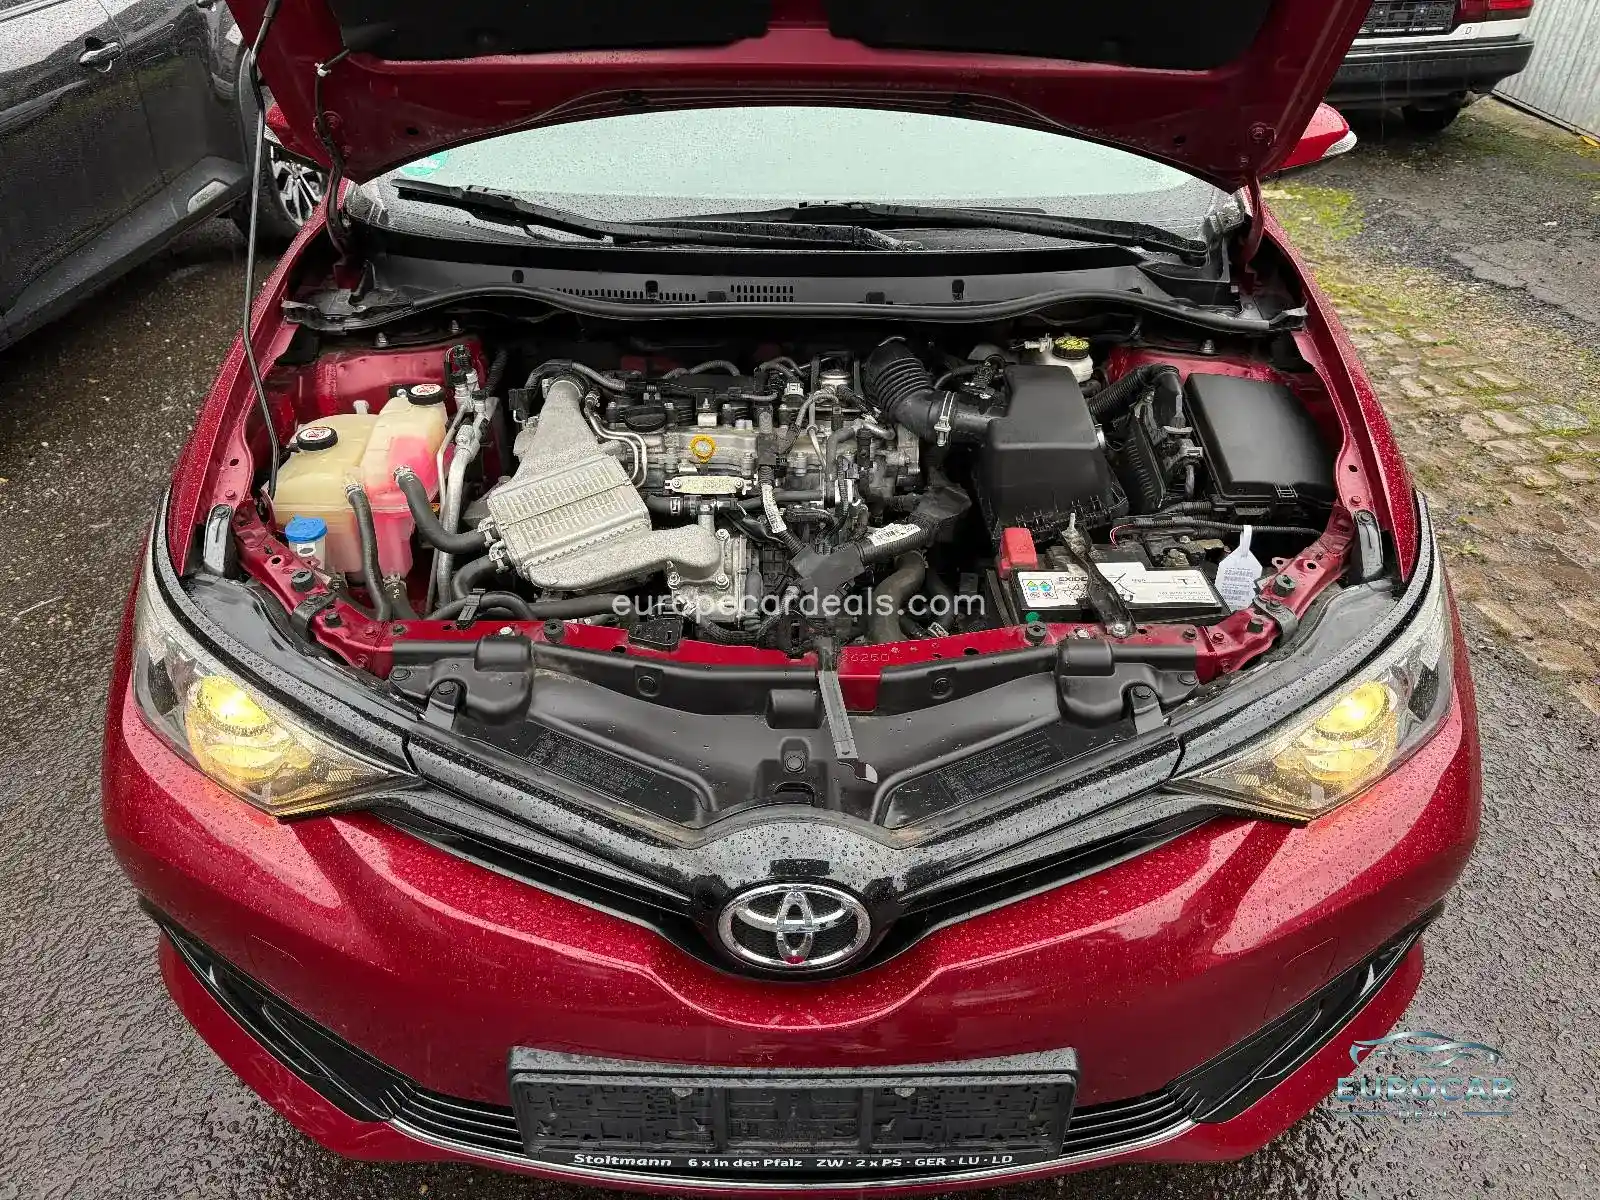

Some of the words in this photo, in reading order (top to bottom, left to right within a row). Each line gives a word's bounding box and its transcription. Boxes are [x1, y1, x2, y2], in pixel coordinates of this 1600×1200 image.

[574, 1154, 672, 1167] Stoltmann
[688, 1158, 698, 1167] 6
[714, 1158, 728, 1167] in
[732, 1158, 759, 1167] der
[763, 1158, 803, 1168] Pfalz
[816, 1158, 844, 1167] ZW
[856, 1158, 866, 1167] 2
[881, 1158, 902, 1167] PS
[914, 1157, 947, 1166] GER
[958, 1156, 979, 1165] LU
[991, 1155, 1013, 1164] LD
